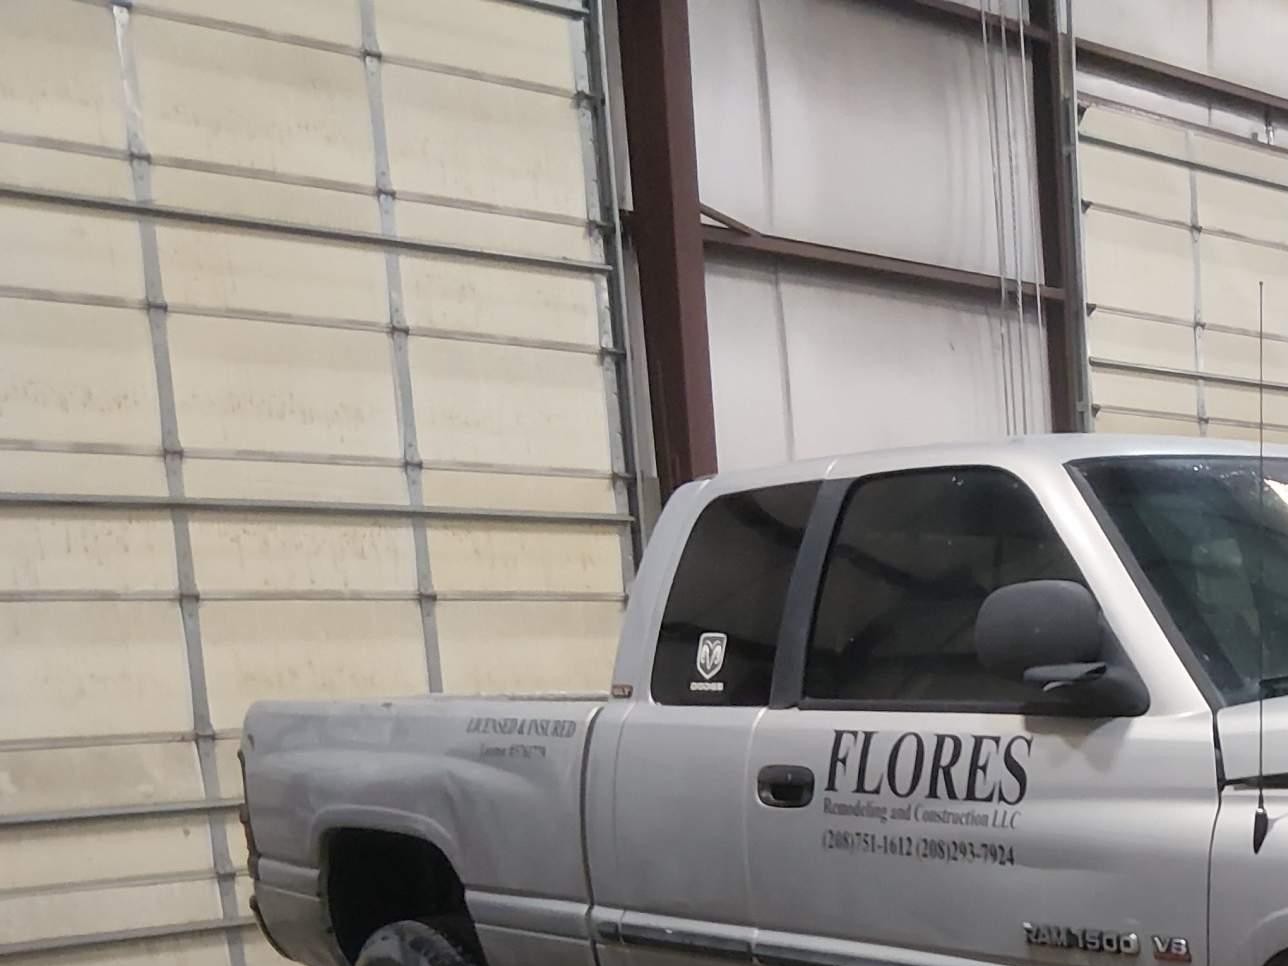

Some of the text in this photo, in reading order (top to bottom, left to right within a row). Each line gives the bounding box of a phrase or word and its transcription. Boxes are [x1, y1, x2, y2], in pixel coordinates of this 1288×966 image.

[824, 729, 1034, 806] FLORES
[823, 797, 1022, 830] Remodeling and Construction LLC
[1023, 921, 1191, 958] RAM 1500 V8
